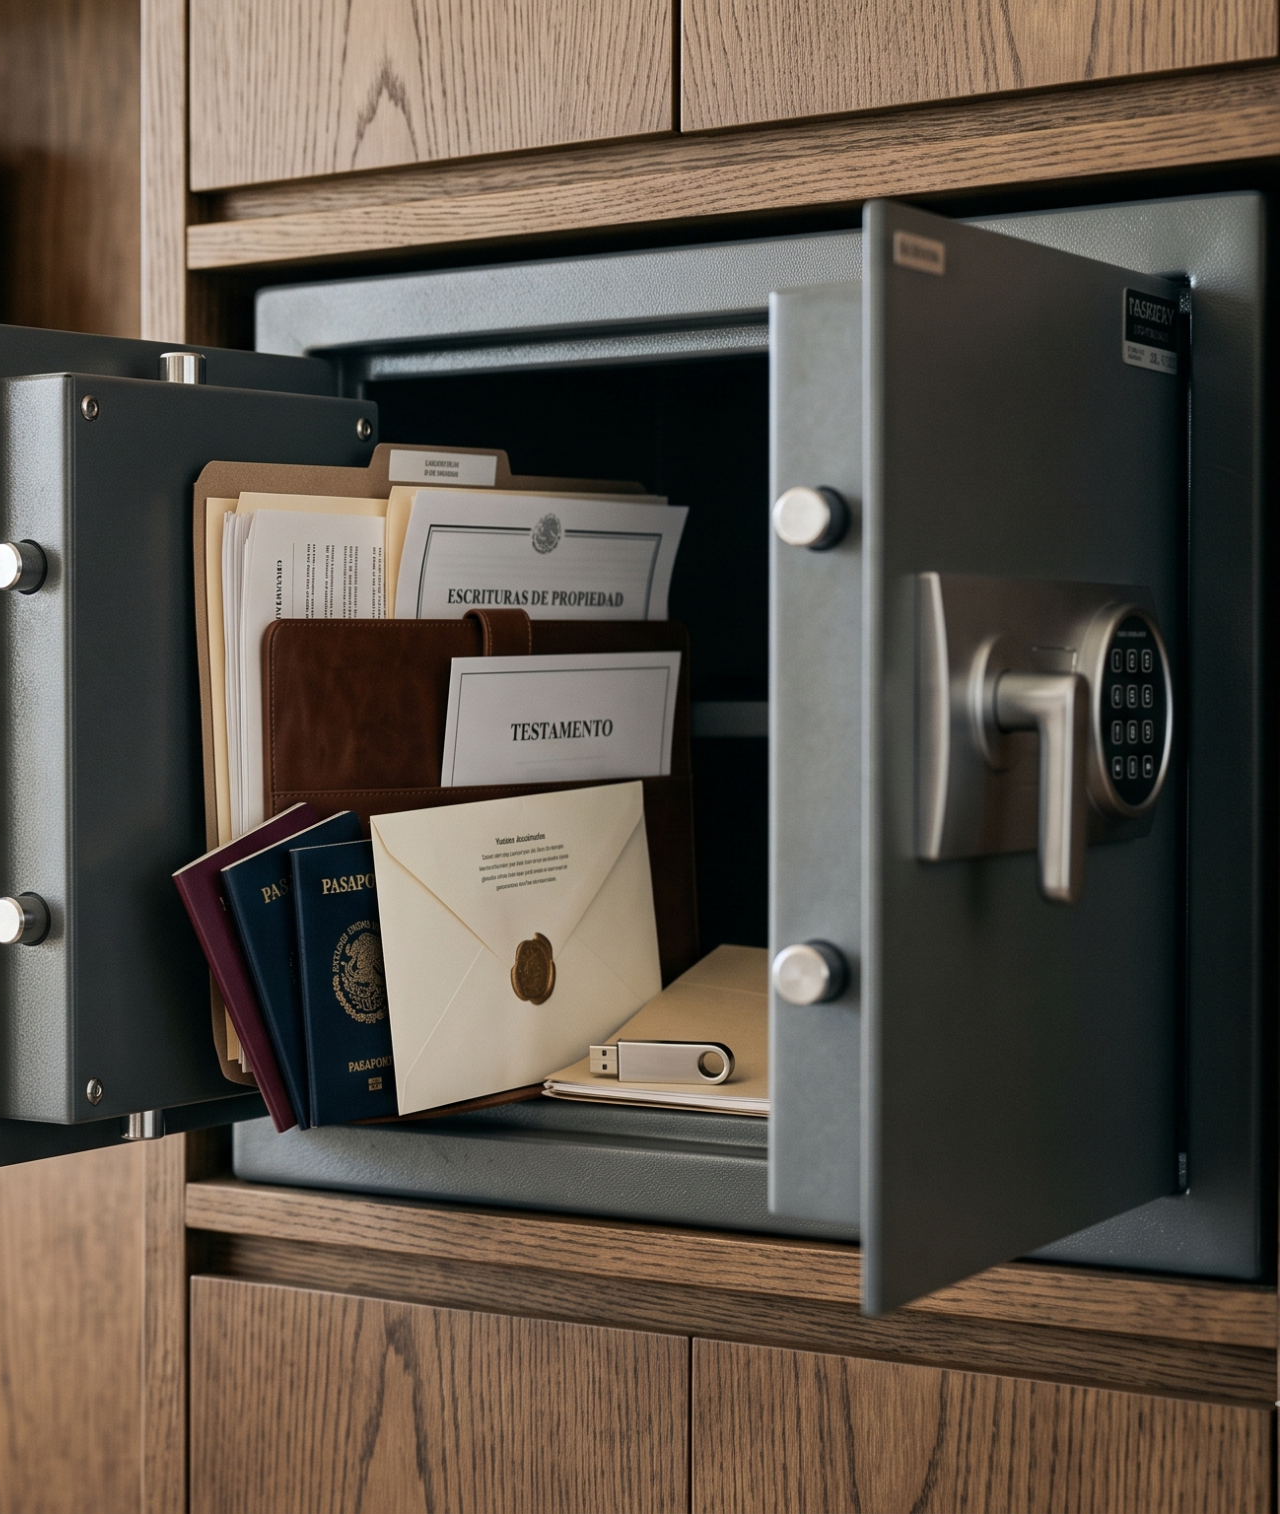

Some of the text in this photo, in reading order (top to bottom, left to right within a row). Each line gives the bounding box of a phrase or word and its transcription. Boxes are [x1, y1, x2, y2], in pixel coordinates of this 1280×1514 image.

[447, 588, 624, 608] ESCRITURAS DE PROPIEDAD
[510, 718, 614, 741] TESTAMENTO
[261, 875, 293, 904] PAS
